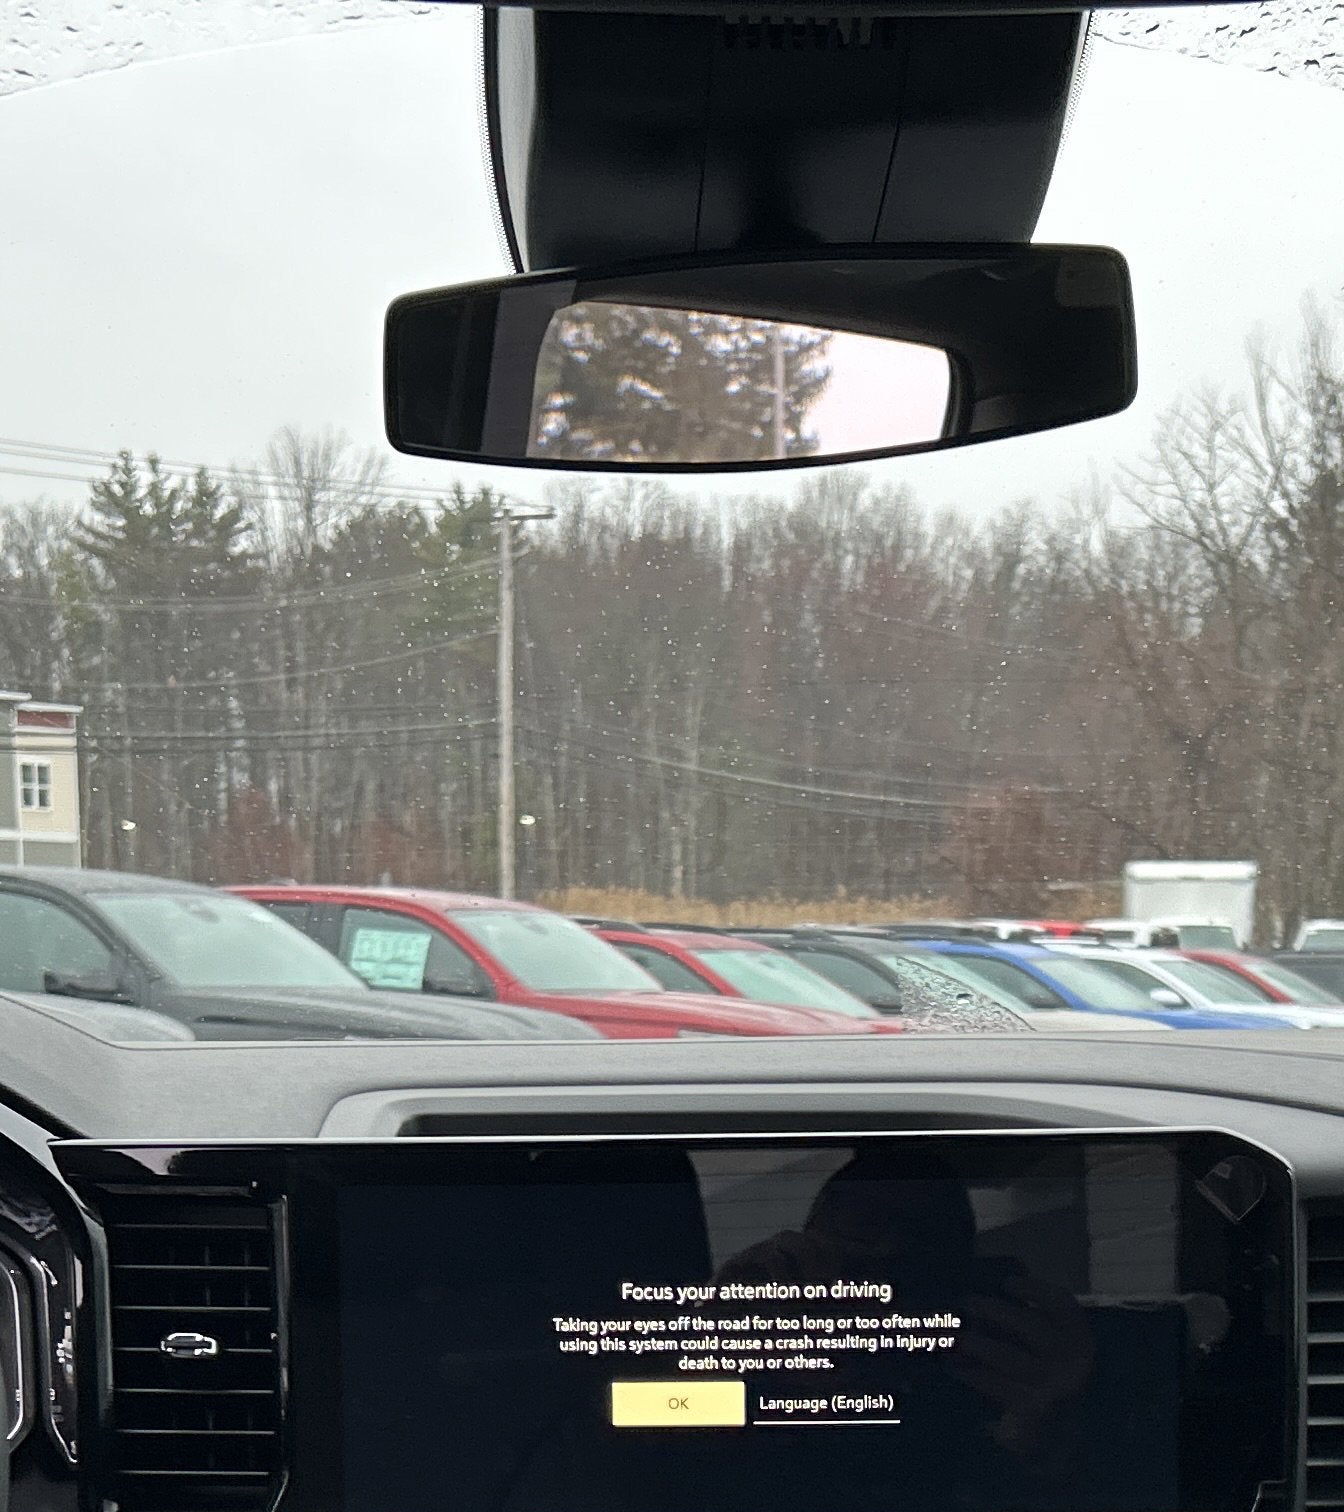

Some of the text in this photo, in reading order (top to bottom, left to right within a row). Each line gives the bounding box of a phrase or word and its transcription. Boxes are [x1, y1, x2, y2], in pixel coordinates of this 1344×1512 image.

[621, 1279, 892, 1304] Focus your attention on driving
[552, 1312, 961, 1335] Taking your eyes off the road for too long or too often while
[559, 1334, 955, 1355] using this system could cause a crash resulting in injury or
[678, 1354, 835, 1374] death to you or others.
[668, 1398, 689, 1409] OK
[759, 1394, 894, 1412] Language (English)
